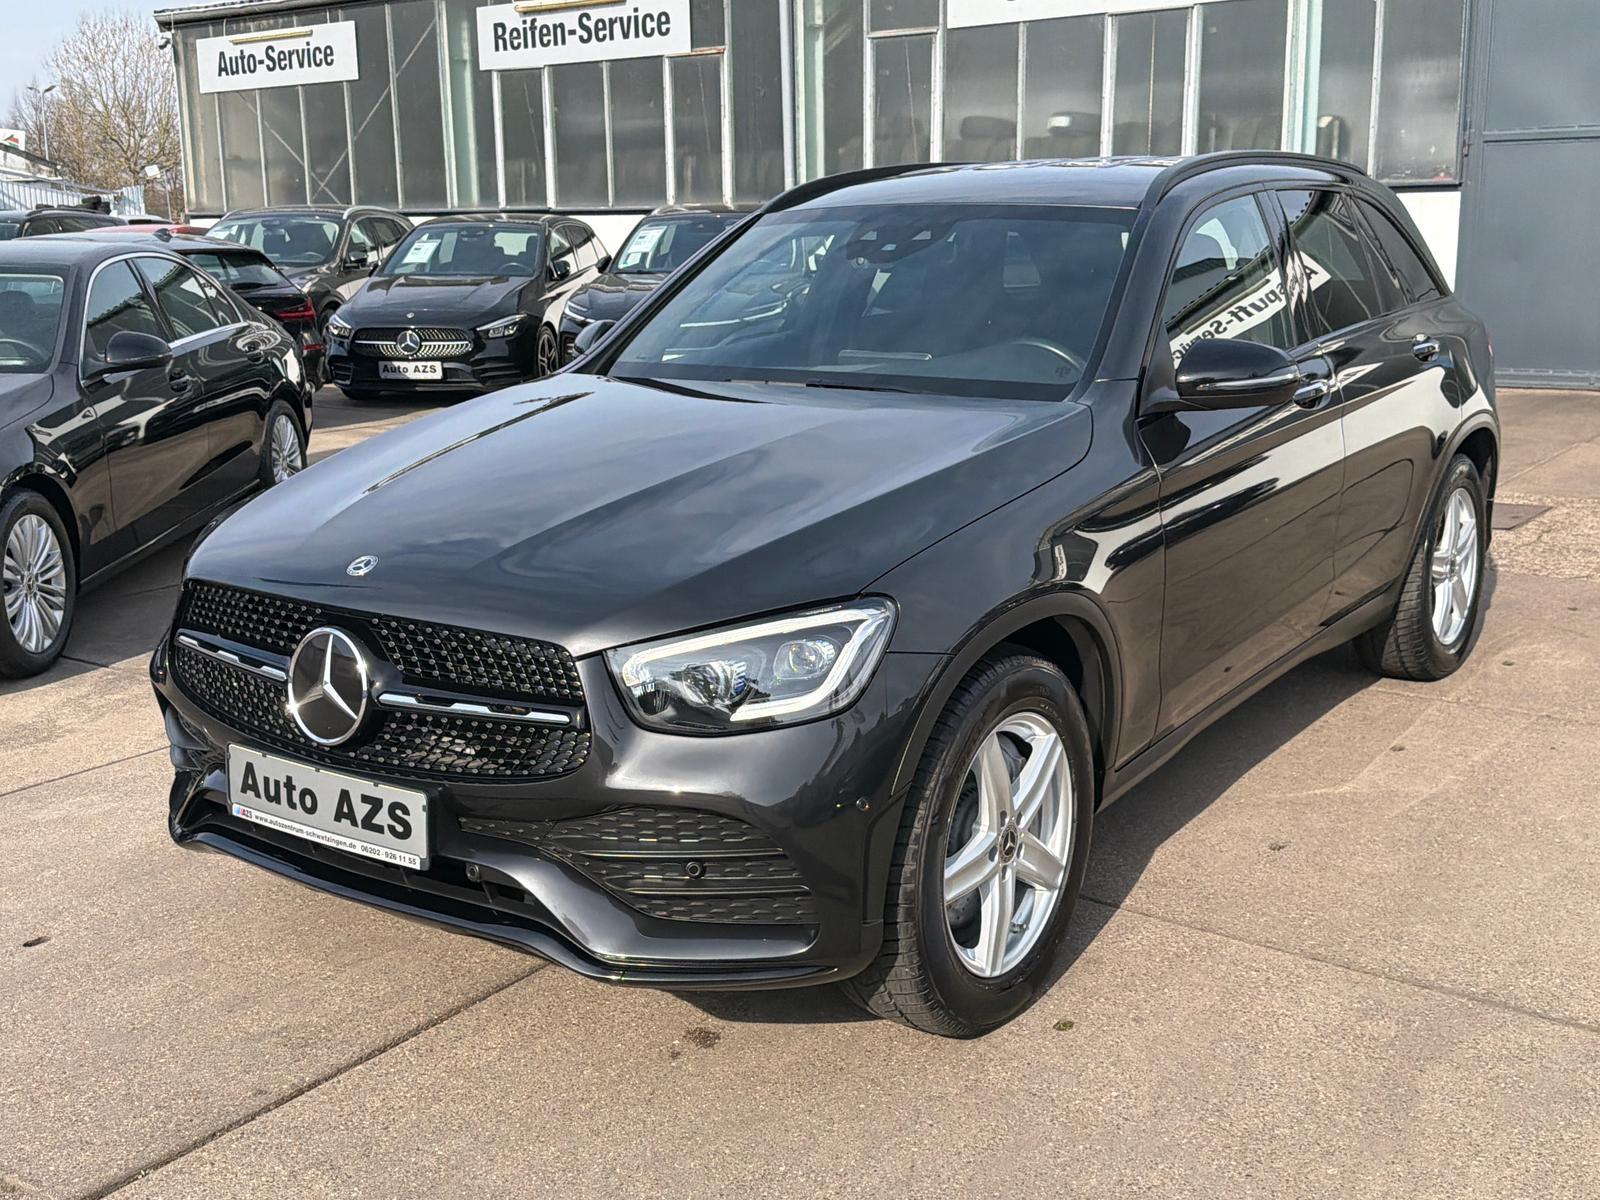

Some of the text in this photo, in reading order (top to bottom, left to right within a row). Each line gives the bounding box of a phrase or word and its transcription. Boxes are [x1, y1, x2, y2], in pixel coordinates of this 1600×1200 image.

[493, 7, 671, 52] Reifen-Service
[217, 41, 335, 77] Auto-Service
[382, 364, 437, 373] Auto AZS
[240, 761, 412, 840] Auto AZS
[254, 814, 357, 850] www.autozentrum-schwetzingen.de
[360, 845, 381, 857] 06202
[384, 851, 397, 862] 926
[398, 855, 406, 863] 11
[408, 857, 417, 866] 55
